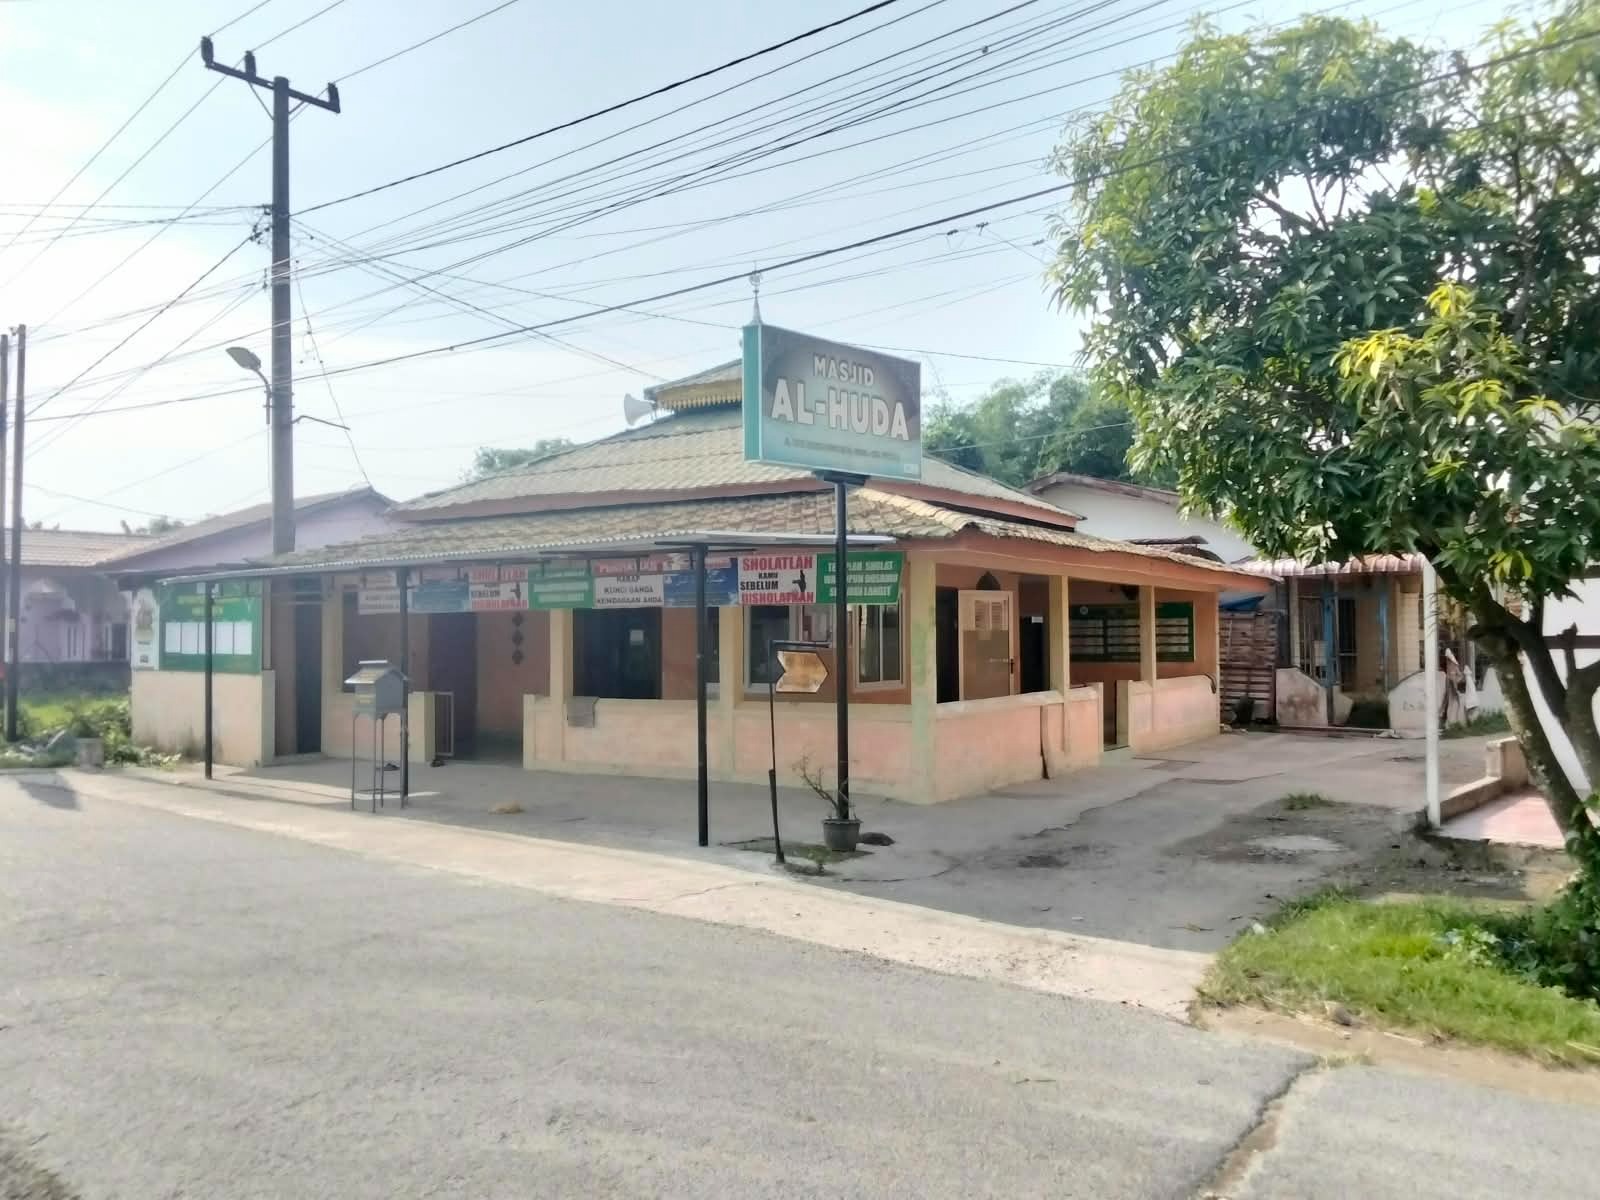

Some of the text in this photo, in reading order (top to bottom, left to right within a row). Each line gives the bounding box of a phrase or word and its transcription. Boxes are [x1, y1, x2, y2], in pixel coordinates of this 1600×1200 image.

[813, 355, 874, 386] MASJID
[771, 378, 909, 441] AL-HUDA
[740, 581, 778, 591] SEBELUM
